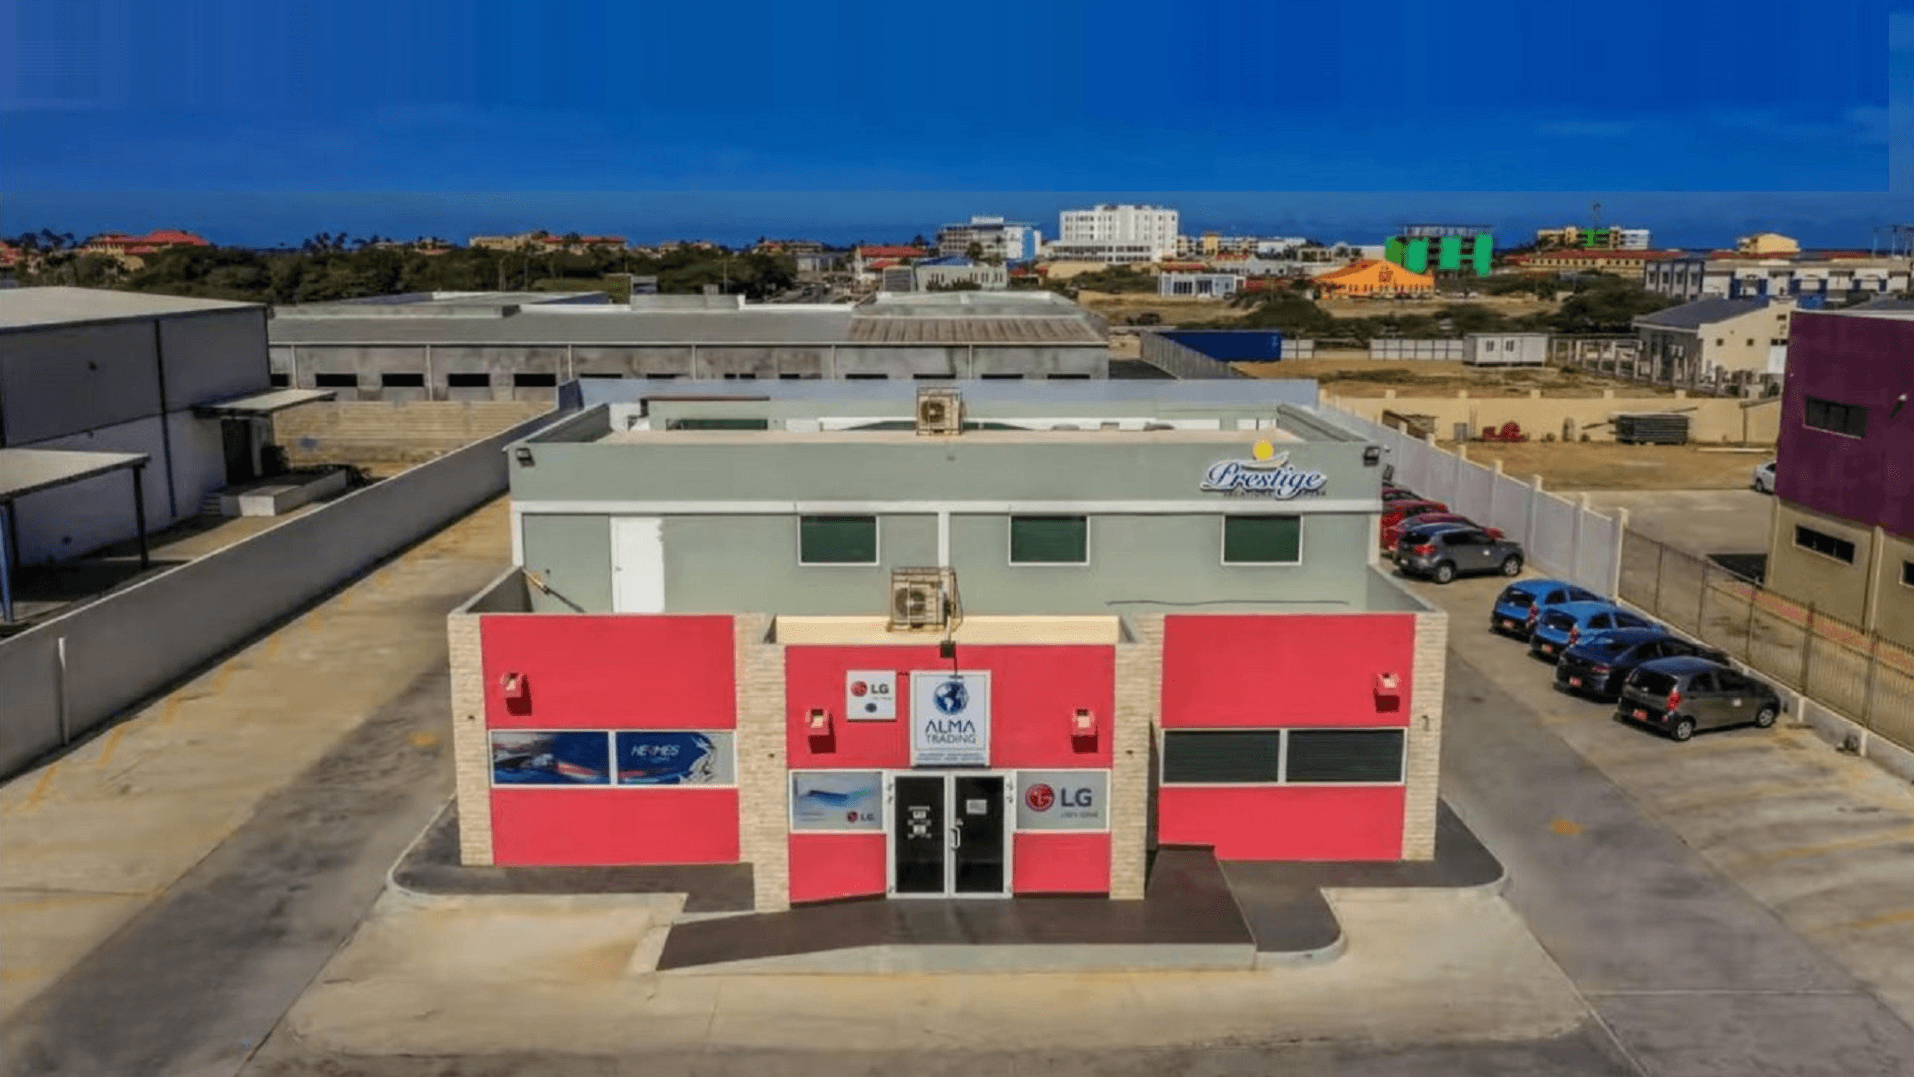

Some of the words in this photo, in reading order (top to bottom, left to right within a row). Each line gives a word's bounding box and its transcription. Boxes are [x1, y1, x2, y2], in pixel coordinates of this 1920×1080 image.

[1203, 461, 1325, 498] Prestige
[870, 683, 889, 694] LG
[925, 719, 976, 733] ALMA
[927, 733, 976, 744] TRADING
[1060, 787, 1092, 807] LG
[860, 813, 874, 821] LG
